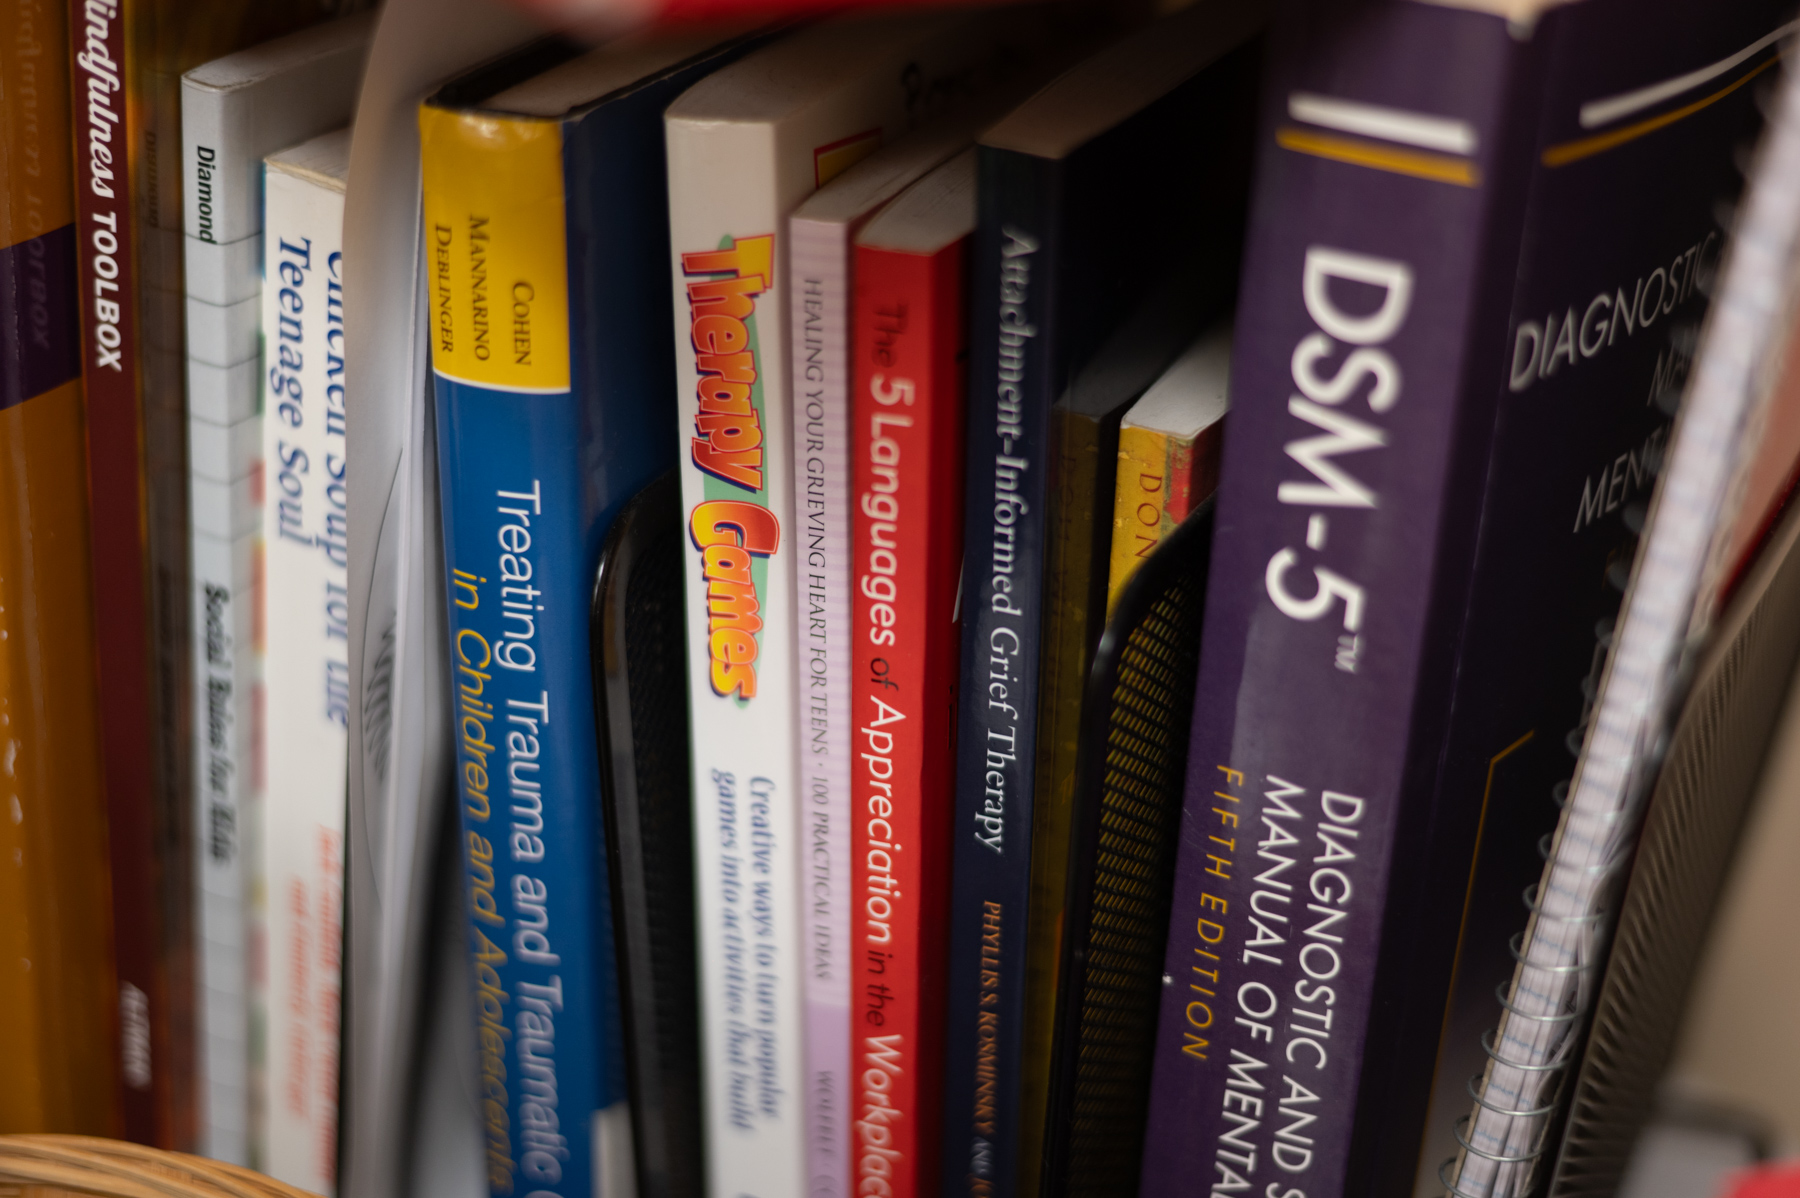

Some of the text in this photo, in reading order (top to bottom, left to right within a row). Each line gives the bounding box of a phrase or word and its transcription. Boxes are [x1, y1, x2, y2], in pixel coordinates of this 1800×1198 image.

[197, 145, 217, 244] Diamond
[92, 211, 122, 372] TOOLBOX
[270, 237, 312, 547] Teenage Soul
[681, 234, 780, 703] Therapy Games
[452, 567, 487, 610] in
[494, 480, 545, 673] Treating
[975, 227, 1038, 853] Attachment-Informed Grief Therapy
[1134, 473, 1162, 558] DON
[804, 279, 834, 981] HEALING YOUR GRIEVING HEART FOR TEENS 100 PRACTICAL IDEAS
[456, 629, 495, 820] Children
[506, 691, 549, 862] Trauma
[855, 300, 915, 1198] The 5 Languages of Appreciation in the Workplac
[467, 830, 506, 928] and
[710, 768, 736, 849] games
[720, 855, 742, 903] into
[750, 776, 774, 875] Creative
[511, 874, 561, 965] and
[753, 880, 774, 937] ways
[980, 900, 1002, 988] PHYLLIS
[1181, 764, 1243, 1059] FIFTH EDITION
[1210, 775, 1306, 1198] MANUAL OF MENTA
[1284, 790, 1364, 1070] DIAGNOSTIC
[515, 975, 570, 1186] Traumatic
[973, 1010, 1000, 1135] KOSMINSKY
[1272, 1075, 1320, 1171] AND
